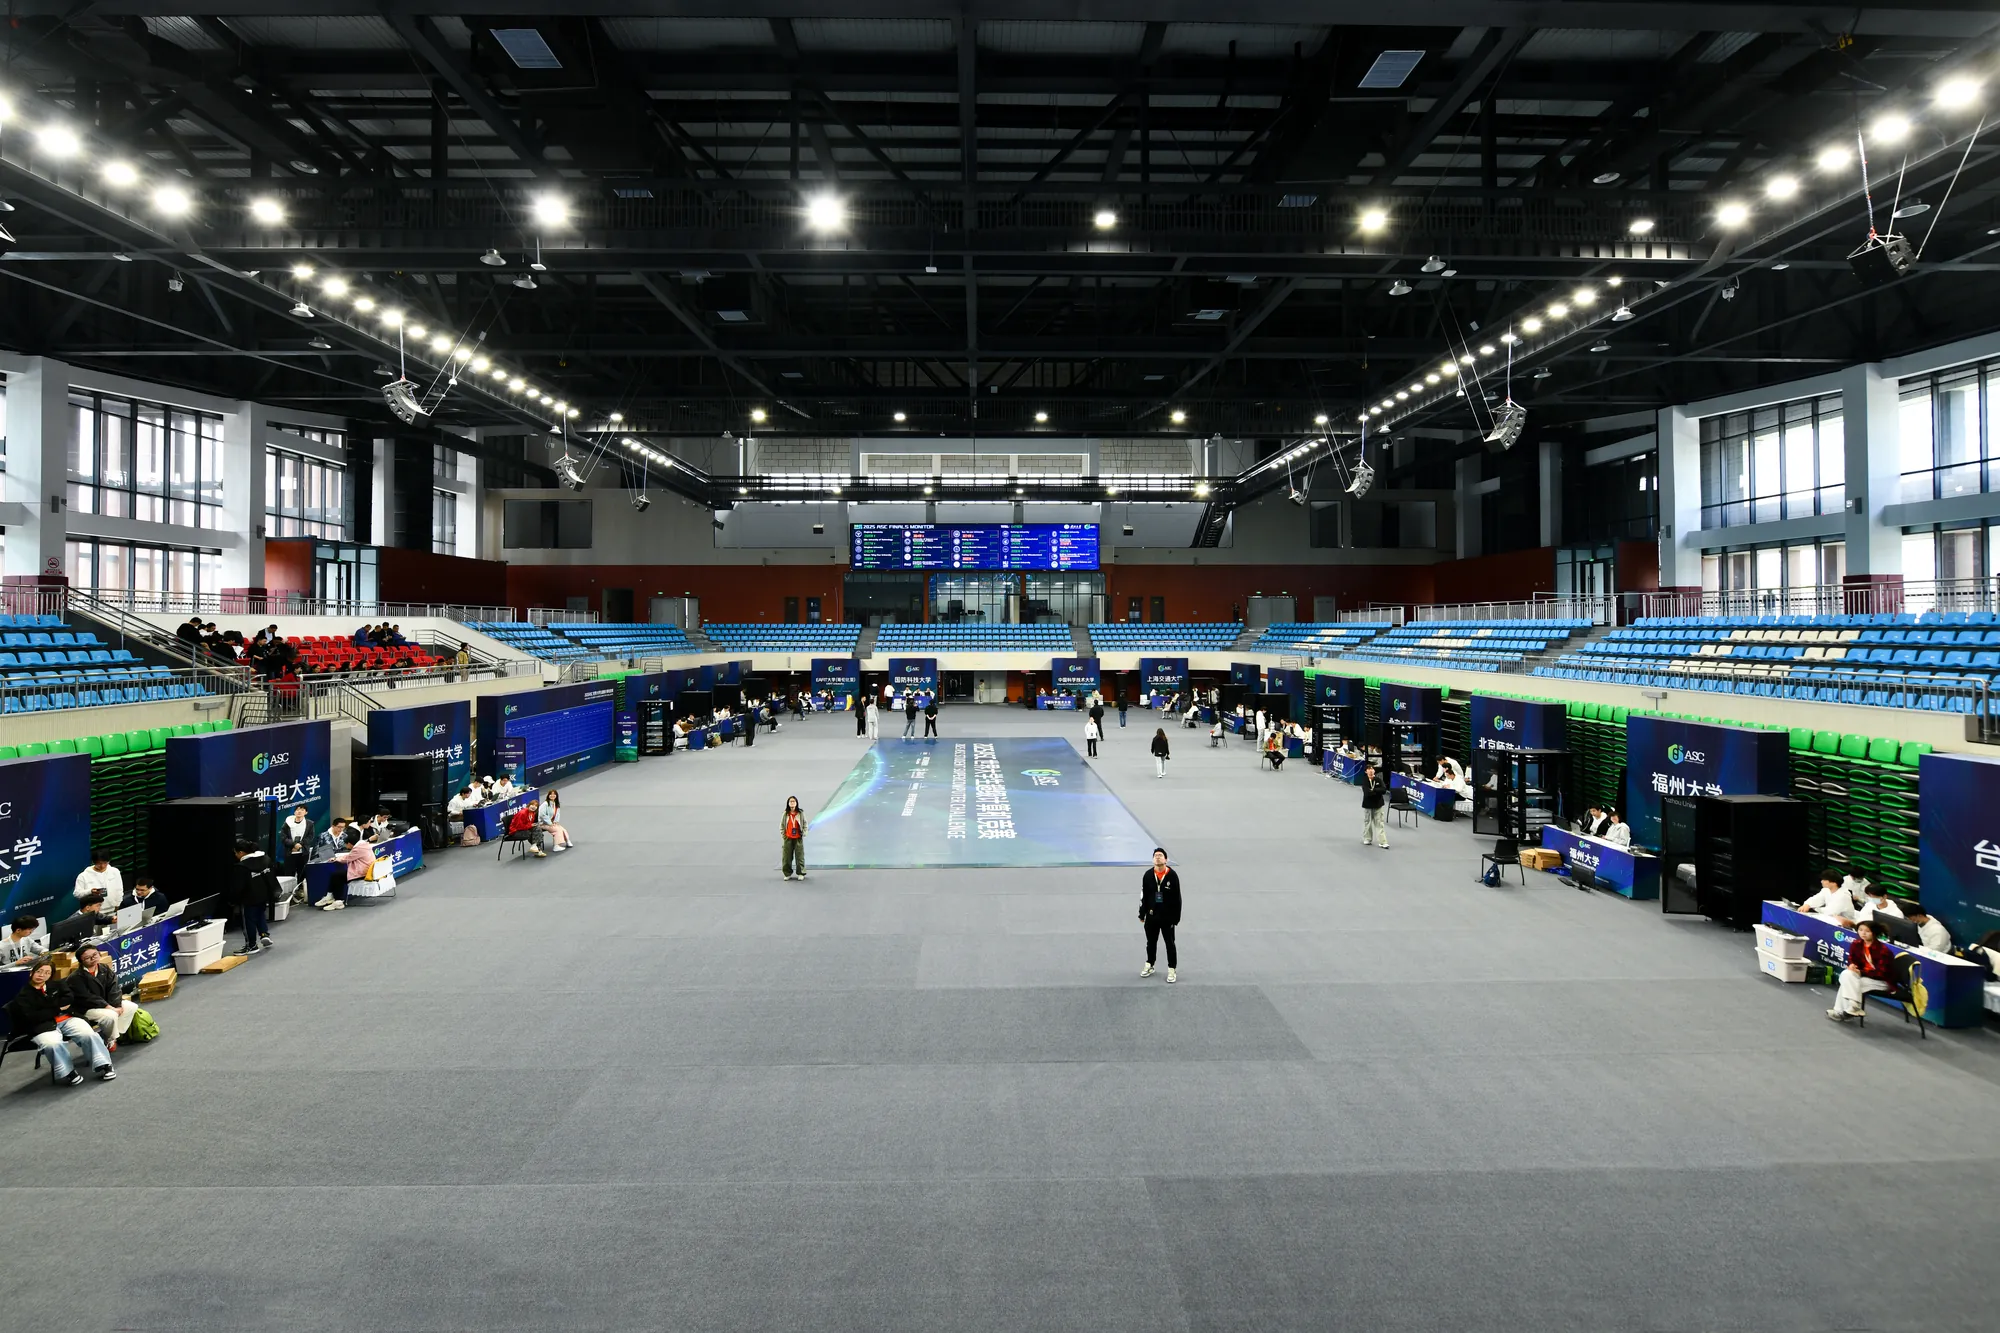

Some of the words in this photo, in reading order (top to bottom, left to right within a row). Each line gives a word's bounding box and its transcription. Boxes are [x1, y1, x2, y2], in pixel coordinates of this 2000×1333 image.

[434, 724, 446, 733] ASC
[1503, 719, 1516, 728] ASC
[1478, 736, 1533, 750] 北京师范
[269, 752, 289, 765] ASC
[1684, 750, 1705, 762] ASC
[233, 774, 321, 803] 邮电大学
[1651, 771, 1723, 796] 福州大学
[281, 795, 321, 810] Telecommunications
[947, 803, 966, 839] CHALLENGE
[1569, 847, 1600, 867] 福州大学
[131, 935, 143, 945] ASC
[1816, 939, 1850, 963] 台湾
[130, 958, 157, 973] University
[1820, 954, 1840, 967] Taiwan
